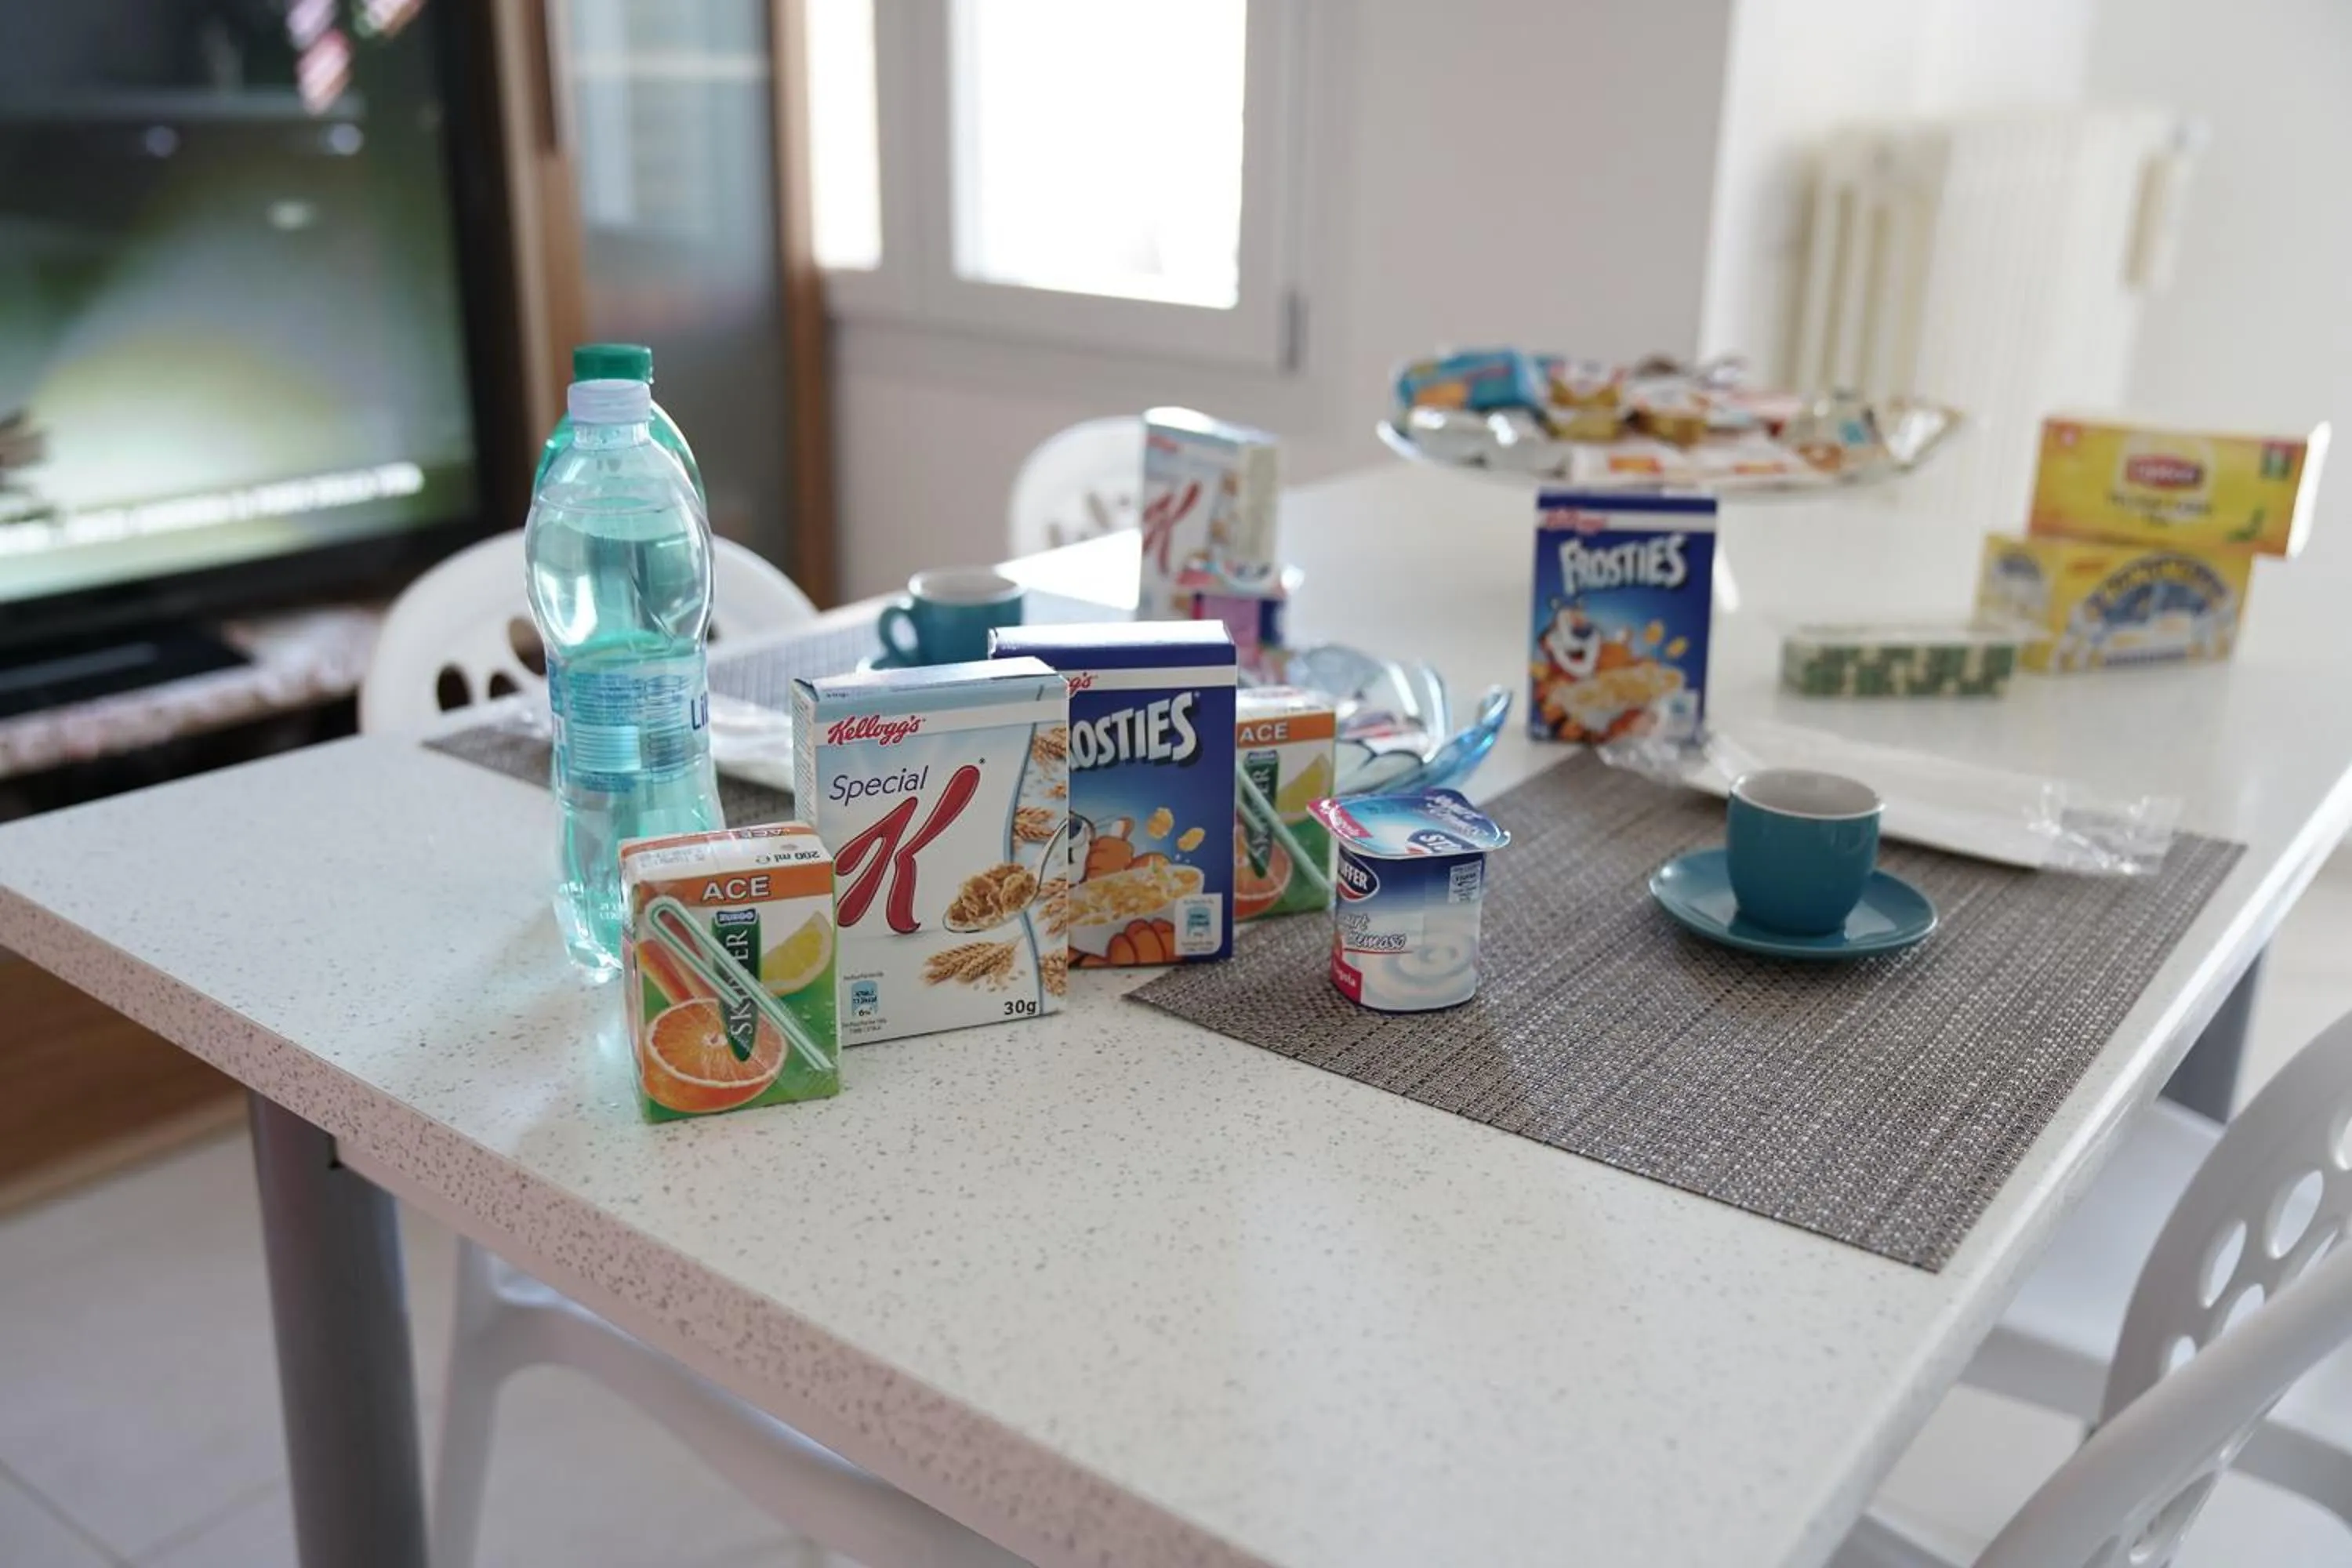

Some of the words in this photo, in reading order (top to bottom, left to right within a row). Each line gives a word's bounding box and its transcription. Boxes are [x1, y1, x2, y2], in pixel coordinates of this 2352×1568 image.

[1559, 533, 1688, 597] FROSTIES
[827, 714, 922, 746] Kellogg's
[1069, 691, 1197, 772] OSTIES
[1240, 720, 1288, 743] ACE
[829, 764, 929, 807] Special
[833, 764, 981, 935] K
[702, 876, 771, 902] ACE
[1341, 862, 1368, 891] FFER
[726, 929, 753, 1036] SKER
[1004, 1000, 1037, 1015] 30g
